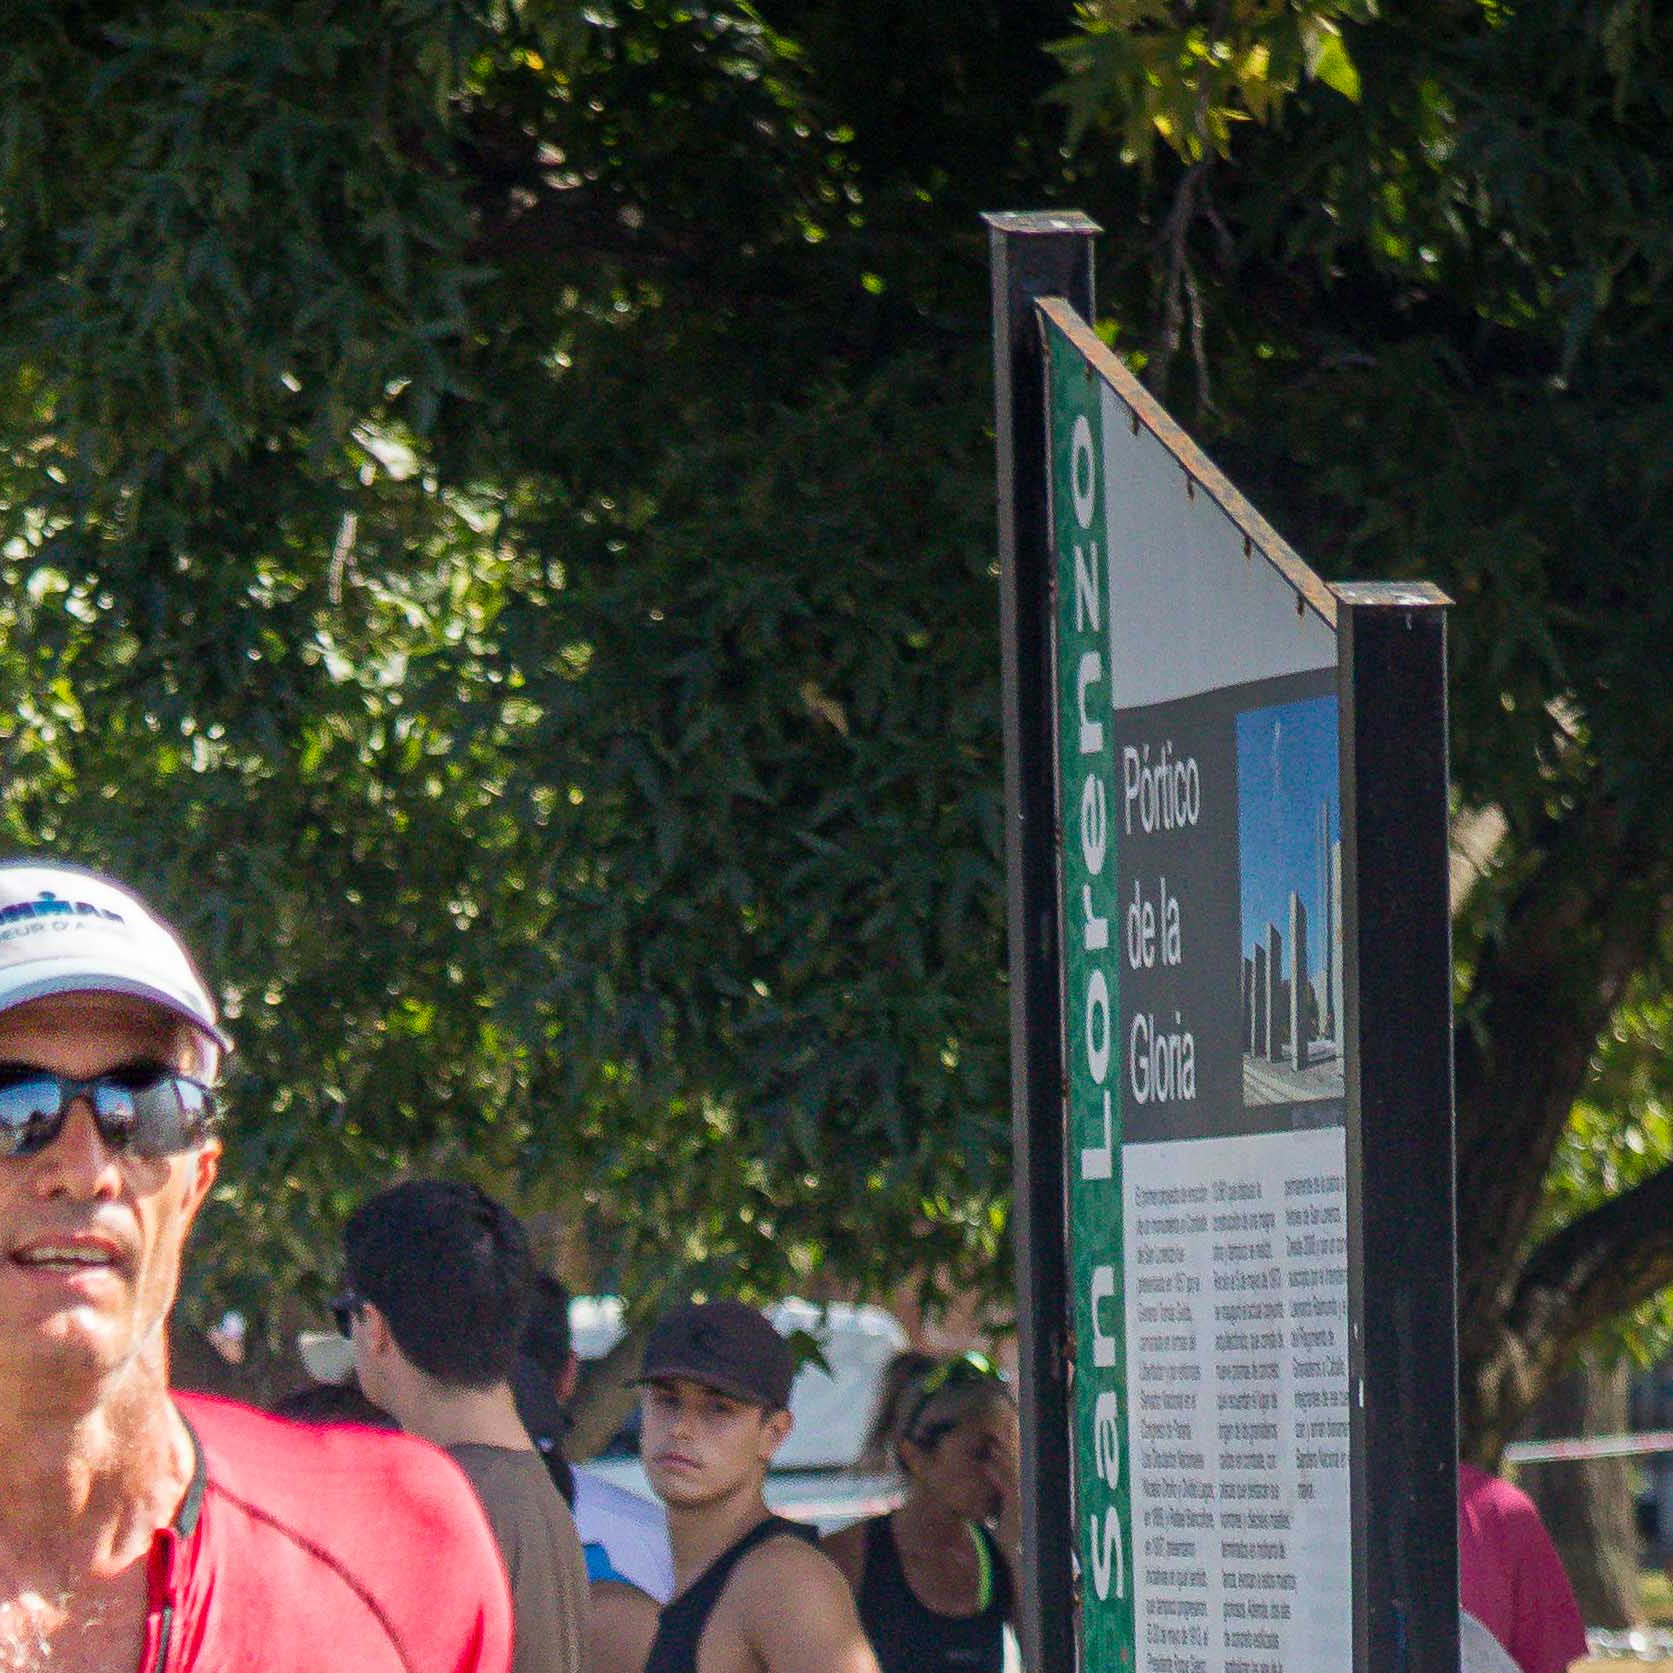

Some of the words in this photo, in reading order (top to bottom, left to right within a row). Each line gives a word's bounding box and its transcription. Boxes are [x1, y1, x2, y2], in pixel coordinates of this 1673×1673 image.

[1072, 414, 1113, 1181] Lorenzo
[1124, 743, 1200, 836] Pórtico
[1128, 880, 1156, 967] de
[1160, 877, 1181, 967] la
[1130, 1010, 1197, 1106] Gloria
[1091, 1265, 1124, 1601] San
